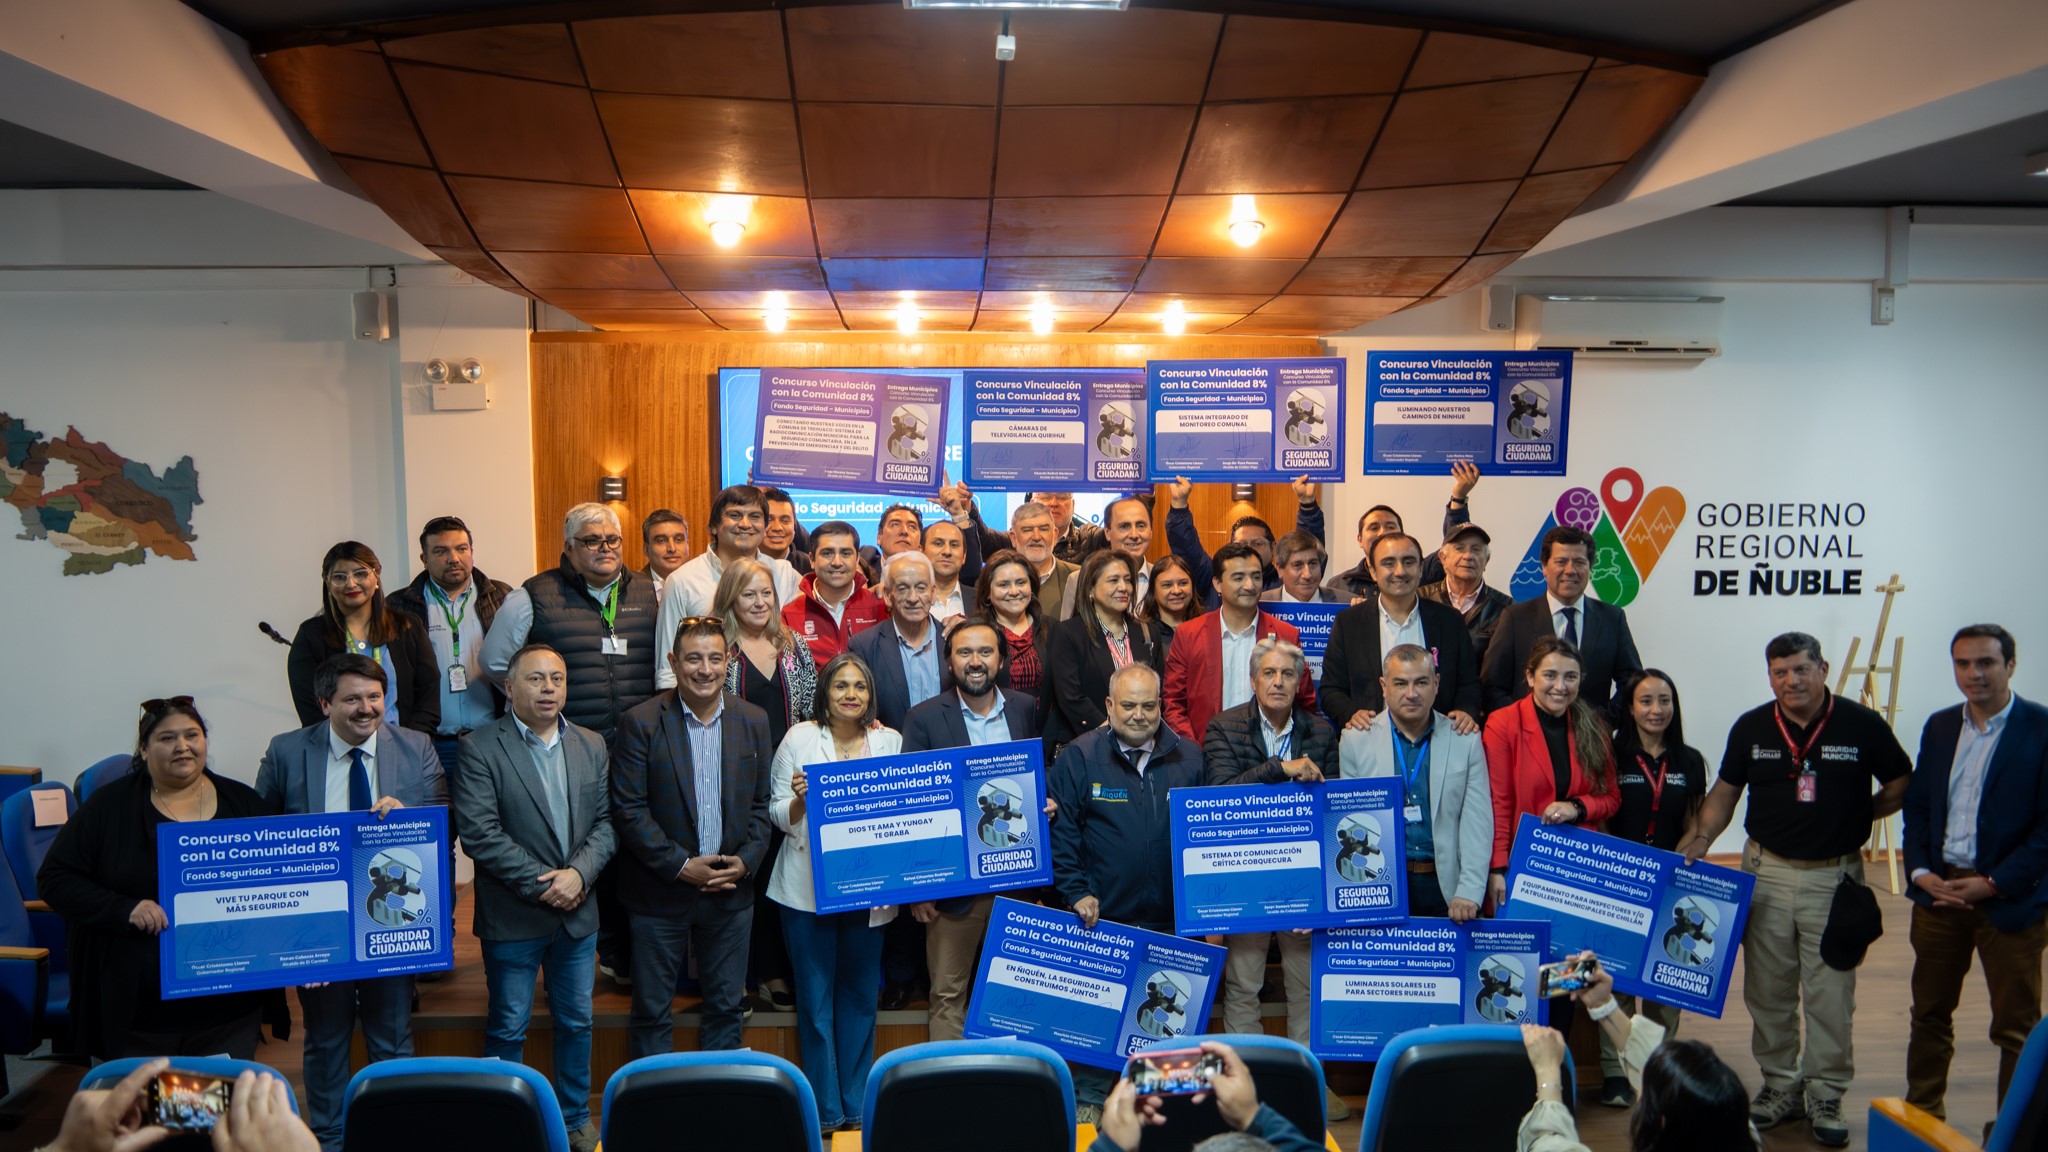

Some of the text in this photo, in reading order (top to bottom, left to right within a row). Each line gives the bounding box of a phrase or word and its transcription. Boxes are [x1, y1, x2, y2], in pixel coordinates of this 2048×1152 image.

[1379, 359, 1492, 368] Concurso Vinculación
[1159, 367, 1268, 377] Concurso Vinculación
[1401, 371, 1411, 380] la
[1412, 371, 1474, 380] Comunidad
[1475, 371, 1491, 380] 8%
[772, 377, 876, 391] Concurso Vinculación
[975, 380, 1081, 390] Concurso Vinculación
[1180, 380, 1190, 389] la
[1191, 379, 1250, 389] Comunidad
[1252, 379, 1267, 388] 8%
[791, 388, 800, 397] la
[802, 389, 859, 401] Comunidad
[860, 393, 874, 402] 8%
[996, 391, 1005, 400] la
[1007, 391, 1064, 401] Comunidad
[1066, 392, 1081, 401] 8%
[1285, 451, 1329, 459] SEGURIDAD
[1506, 444, 1551, 452] SEGURIDAD
[1285, 459, 1330, 467] CIUDADANA
[1505, 452, 1551, 460] CIUDADANA
[886, 464, 928, 474] SEGURIDAD
[1097, 462, 1139, 470] SEGURIDAD
[885, 472, 928, 482] CIUDADANA
[1097, 470, 1140, 478] CIUDADANA
[811, 501, 883, 516] Seguridad
[1698, 502, 1866, 528] GOBIERNO
[1695, 534, 1863, 559] REGIONAL
[1694, 562, 1862, 597] DE ÑUBLE
[1821, 745, 1858, 754] SEGURIDAD
[992, 753, 1028, 762] Municipios
[1821, 753, 1858, 761] MUNICIPAL
[820, 760, 952, 784] Concurso Vinculación
[822, 774, 952, 798] con la Comunidad 8%
[1185, 792, 1313, 809] Concurso Vinculación
[1187, 806, 1313, 822] con la Comunidad 8%
[389, 821, 431, 830] Municipios
[848, 826, 867, 834] DIOS
[877, 822, 895, 830] AMA
[902, 818, 933, 827] YUNGAY
[179, 825, 340, 846] Concurso Vinculación
[883, 829, 910, 838] GRABA
[180, 841, 340, 862] con la Comunidad 8%
[981, 849, 1032, 864] SEGURIDAD
[1243, 847, 1302, 857] COMUNICACIÓN
[1533, 828, 1661, 871] Concurso Vinculación
[981, 858, 1034, 874] CIUDADANA
[1212, 857, 1292, 867] CRÍTICA COBQUECURA
[1530, 843, 1656, 883] con la Comunidad 8%
[186, 871, 218, 881] Fondo
[219, 867, 272, 879] Seguridad
[282, 862, 335, 873] Municipios
[215, 896, 236, 904] VIVE
[251, 892, 287, 901] PARQUE
[289, 890, 309, 898] CON
[1338, 886, 1389, 898] SEGURIDAD
[226, 900, 300, 913] MÁS SEGURIDAD
[1338, 895, 1390, 908] CIUDADANA
[1520, 887, 1563, 904] PATRULLEROS
[1564, 899, 1606, 915] MUNICIPALES
[1615, 914, 1643, 926] CHILLÁN
[1522, 880, 1645, 919] EQUIPAMIENTO PARA INSPECTORES Y/O
[1007, 911, 1134, 948] Concurso Vinculación
[1327, 927, 1457, 939] Concurso Vinculación
[370, 929, 430, 945] SEGURIDAD
[1005, 926, 1130, 960] con la Comunidad 8%
[369, 940, 432, 955] CIUDADANA
[1327, 940, 1456, 952] con la Comunidad 8%
[1006, 964, 1016, 972] EN
[1017, 966, 1046, 979] ÑIQUÉN,
[1059, 976, 1101, 990] SEGURIDAD
[1657, 963, 1709, 985] SEGURIDAD
[1014, 975, 1099, 999] CONSTRUIMOS JUNTOS
[1654, 972, 1707, 995] CIUDADANA
